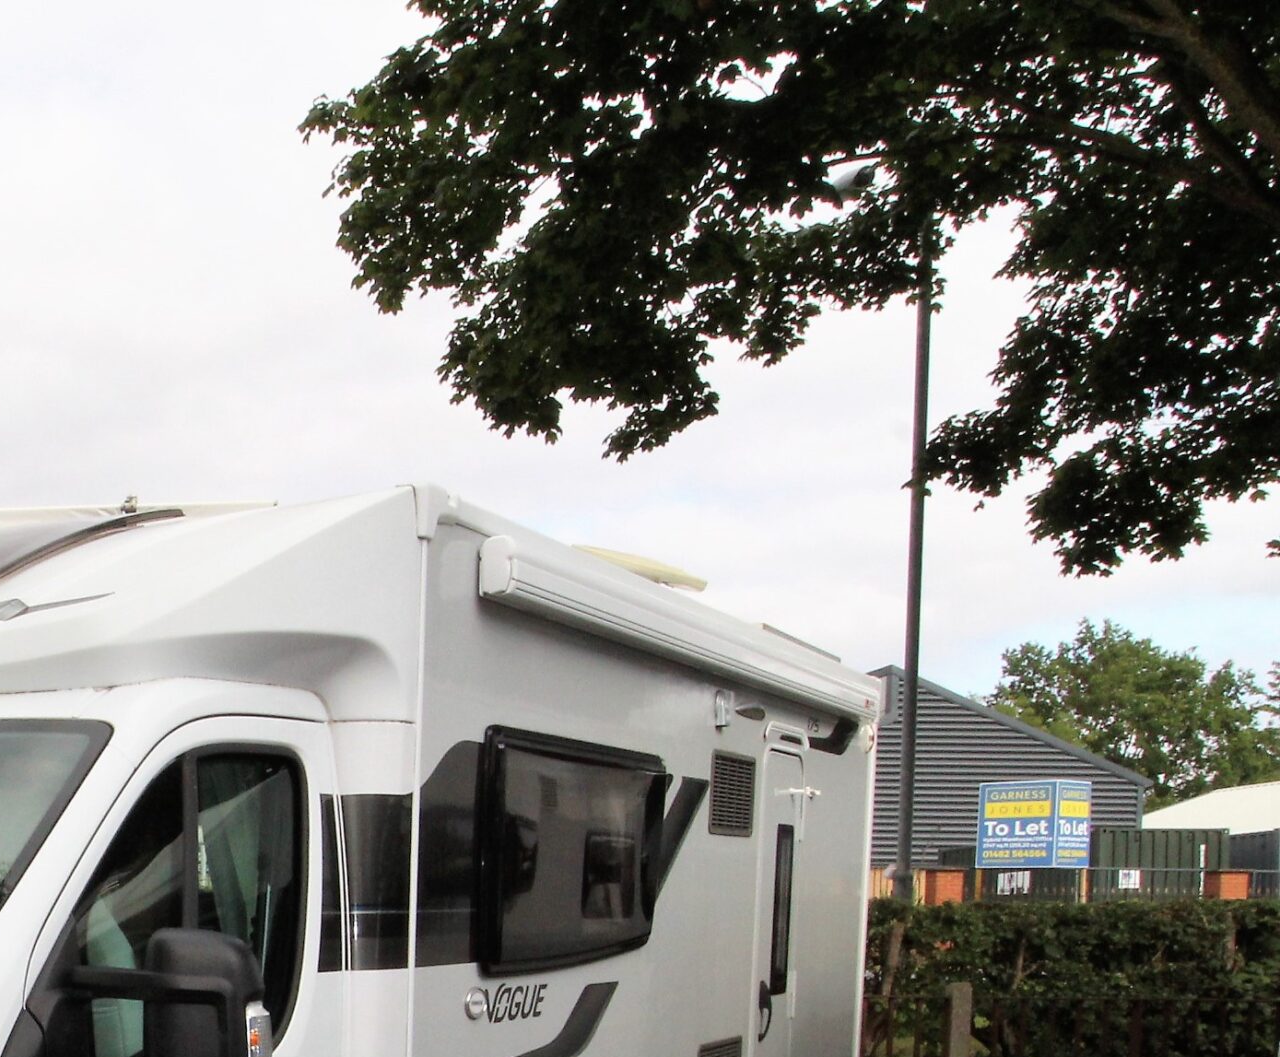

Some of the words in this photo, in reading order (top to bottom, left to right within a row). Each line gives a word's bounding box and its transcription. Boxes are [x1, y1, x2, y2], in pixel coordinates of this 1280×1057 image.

[990, 790, 1046, 800] GARNESS
[990, 804, 1045, 815] JONES
[984, 821, 1009, 836] To
[1014, 820, 1049, 835] Let
[1059, 820, 1071, 835] To
[1073, 820, 1089, 835] Let
[484, 983, 549, 1023] VOGUE
